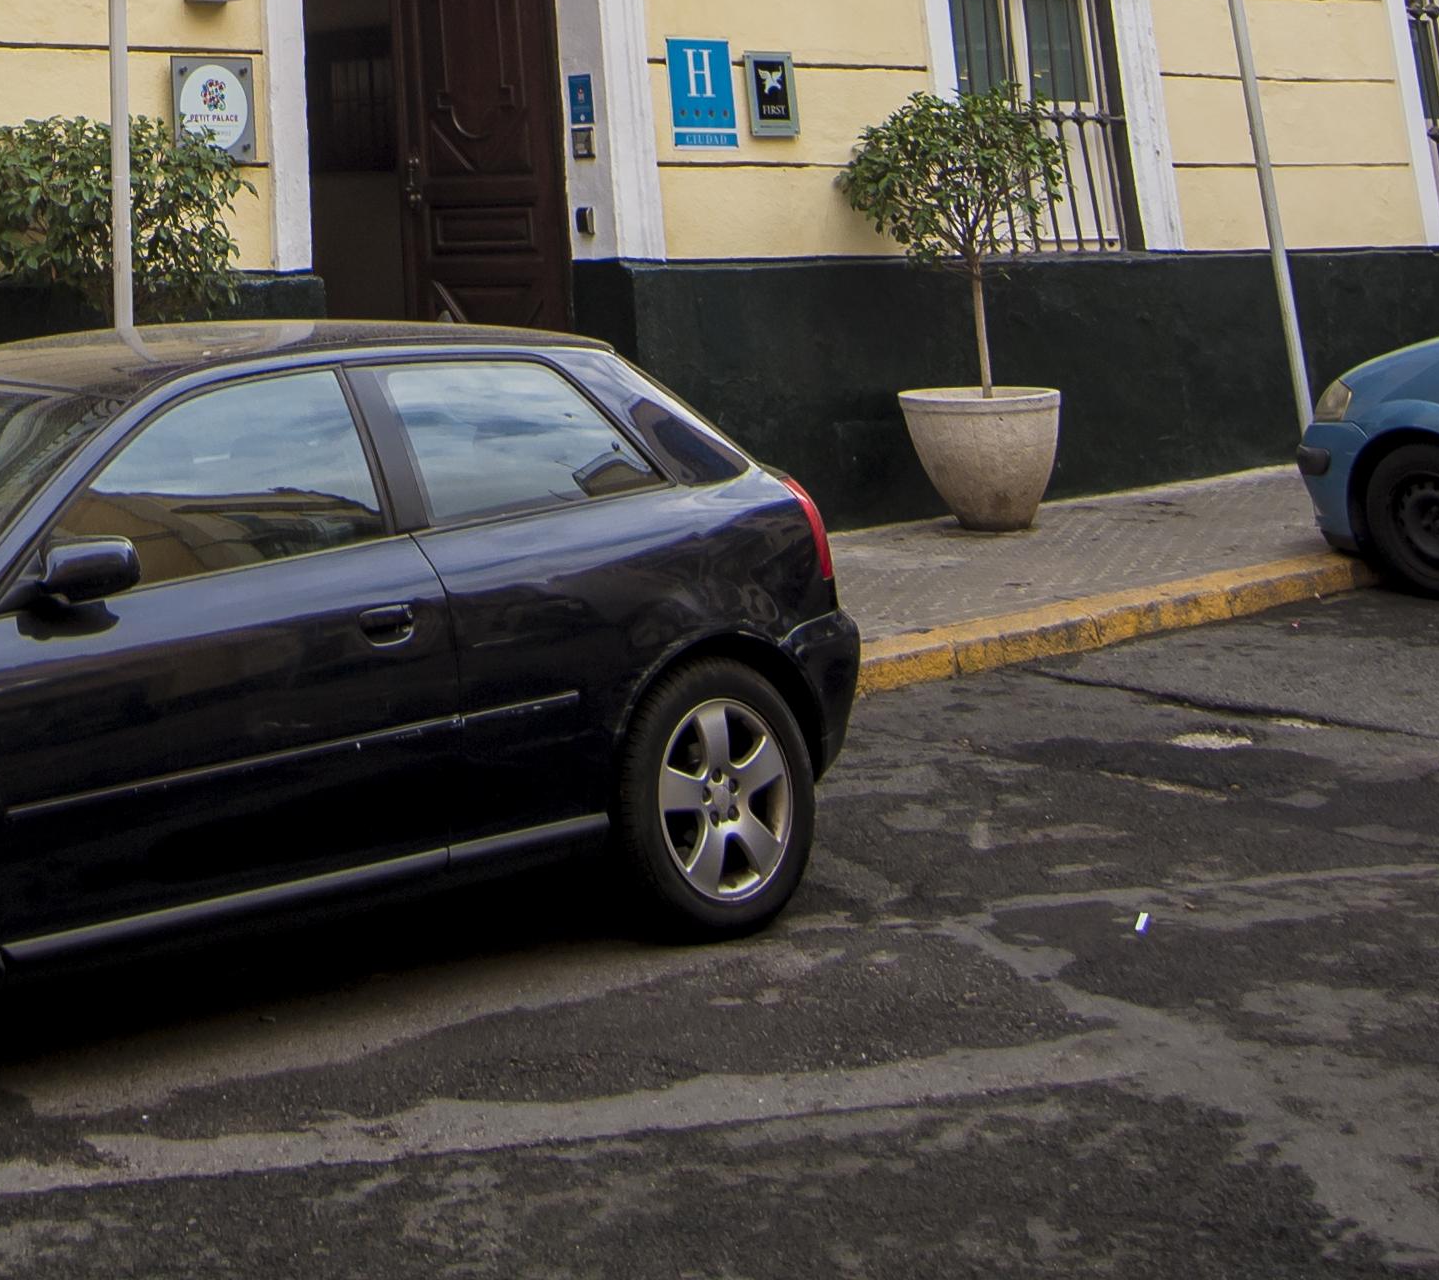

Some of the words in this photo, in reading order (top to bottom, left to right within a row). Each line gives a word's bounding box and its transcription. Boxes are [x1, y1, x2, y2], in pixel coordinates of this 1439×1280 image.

[683, 48, 716, 98] H
[763, 104, 786, 115] FIRST
[190, 113, 210, 122] PETIT
[212, 114, 239, 122] PALACE
[685, 134, 728, 145] CIUDAD
